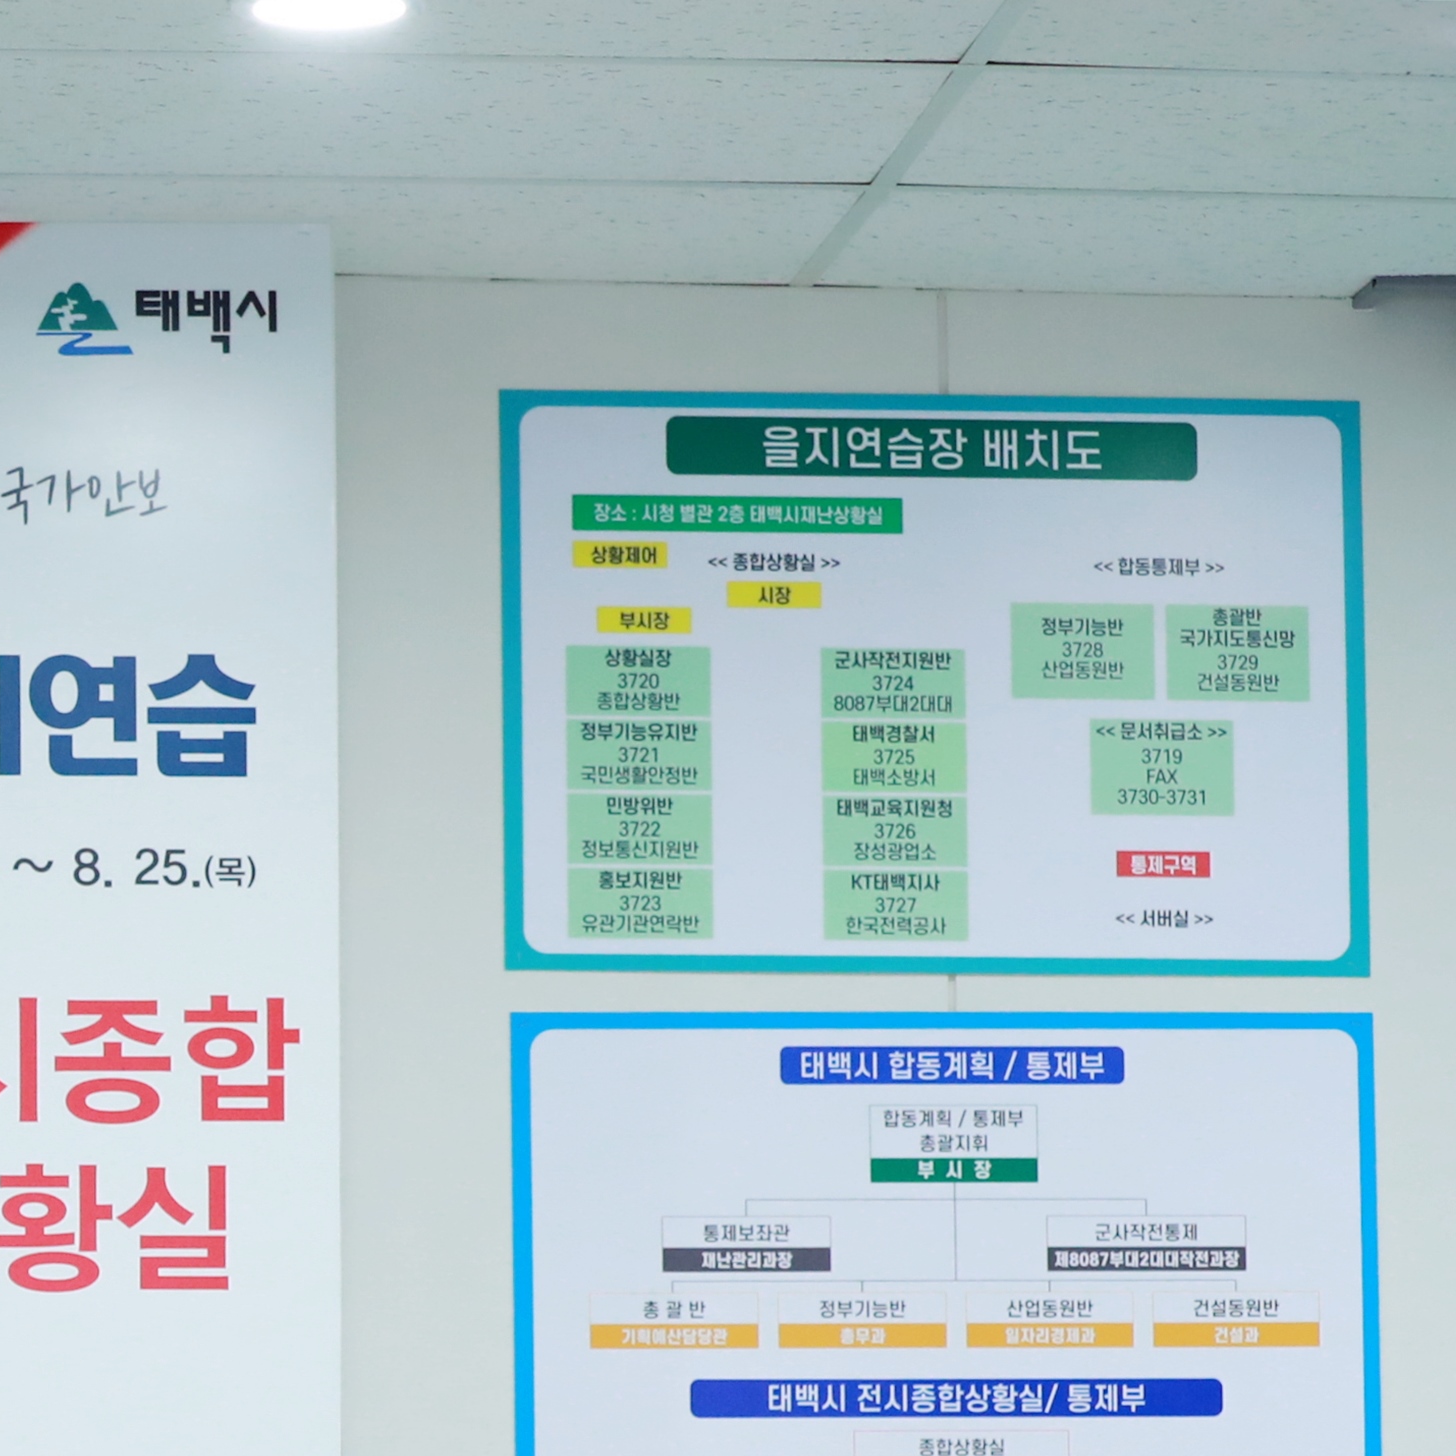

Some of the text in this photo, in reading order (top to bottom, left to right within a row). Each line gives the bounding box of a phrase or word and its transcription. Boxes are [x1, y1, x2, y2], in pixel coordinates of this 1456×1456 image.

[136, 290, 277, 353] 태백시
[763, 427, 1102, 470] 을지연습장 배치도
[1, 466, 166, 525] 국가안보
[595, 504, 626, 522] 장소
[643, 504, 674, 522] 시청
[681, 505, 712, 523] 별관
[719, 505, 744, 523] 2층
[751, 506, 882, 525] 태백시재난상황실
[592, 546, 656, 564] 상황제어
[734, 553, 814, 571] 종합상황실
[1119, 558, 1199, 576] 합동통제부
[759, 587, 791, 605] 시장
[621, 612, 669, 630] 부시장
[1213, 608, 1261, 626] 총괄반
[1042, 618, 1123, 636] 정부기능반
[1181, 629, 1295, 648] 국가지도통신망
[605, 649, 671, 667] 상황실장
[1063, 642, 1103, 658] 3728
[835, 651, 951, 670] 군사작전지원반
[1218, 654, 1258, 670] 3729
[1042, 661, 1124, 679] 산업동원반
[618, 673, 659, 689] 3720
[873, 675, 913, 691] 3724
[1198, 674, 1279, 692] 건설동원반
[598, 692, 680, 711] 종합상황반
[834, 695, 952, 712] 8087부대2대대
[581, 723, 697, 741] 정부기능유지반
[853, 725, 934, 743] 태백경찰서
[1121, 722, 1202, 740] 문서취급소
[619, 747, 657, 762] 3721
[874, 749, 915, 765] 3725
[1142, 748, 1182, 764] 3719
[582, 766, 697, 785] 국민생활안정반
[854, 769, 935, 786] 태백소방서
[1147, 769, 1177, 784] FAX
[607, 797, 673, 815] 민방위반
[1118, 789, 1205, 805] 3730-3731
[837, 799, 952, 818] 태백교육지원청
[619, 821, 660, 837] 3722
[875, 823, 916, 839] 3726
[583, 840, 698, 859] 정보통신지원반
[855, 843, 935, 861] 장성광업소
[1131, 855, 1196, 875] 통제구역
[600, 871, 682, 889] 홍보지원반
[852, 874, 939, 891] KT태백지사
[620, 895, 661, 911] 3723
[875, 897, 916, 913] 3727
[583, 914, 699, 933] 유관기관연락반
[847, 917, 946, 935] 한국전력공사
[1141, 910, 1188, 927] 서버실
[801, 1052, 877, 1079] 태백시
[889, 1051, 993, 1080] 합동계획
[1027, 1052, 1104, 1080] 통제부
[884, 1110, 951, 1128] 합동계획
[974, 1110, 1022, 1127] 통제부
[921, 1134, 987, 1152] 총괄지휘
[705, 1225, 789, 1242] 통제보좌관
[1096, 1224, 1197, 1241] 군사작전통제
[702, 1252, 792, 1268] 재난관리과장
[1055, 1251, 1239, 1267] 제8087부대2대대작전과장
[821, 1301, 905, 1318] 정부기능반
[1008, 1300, 1093, 1318] 산업동원반
[1195, 1300, 1279, 1317] 건설동원반
[623, 1329, 727, 1345] 기획예산담당관
[1006, 1328, 1095, 1344] 일자리경제과
[1216, 1328, 1258, 1343] 건설과
[769, 1384, 845, 1412] 태백시
[1068, 1384, 1145, 1412] 통제부
[920, 1439, 1004, 1456] 종합상황실
